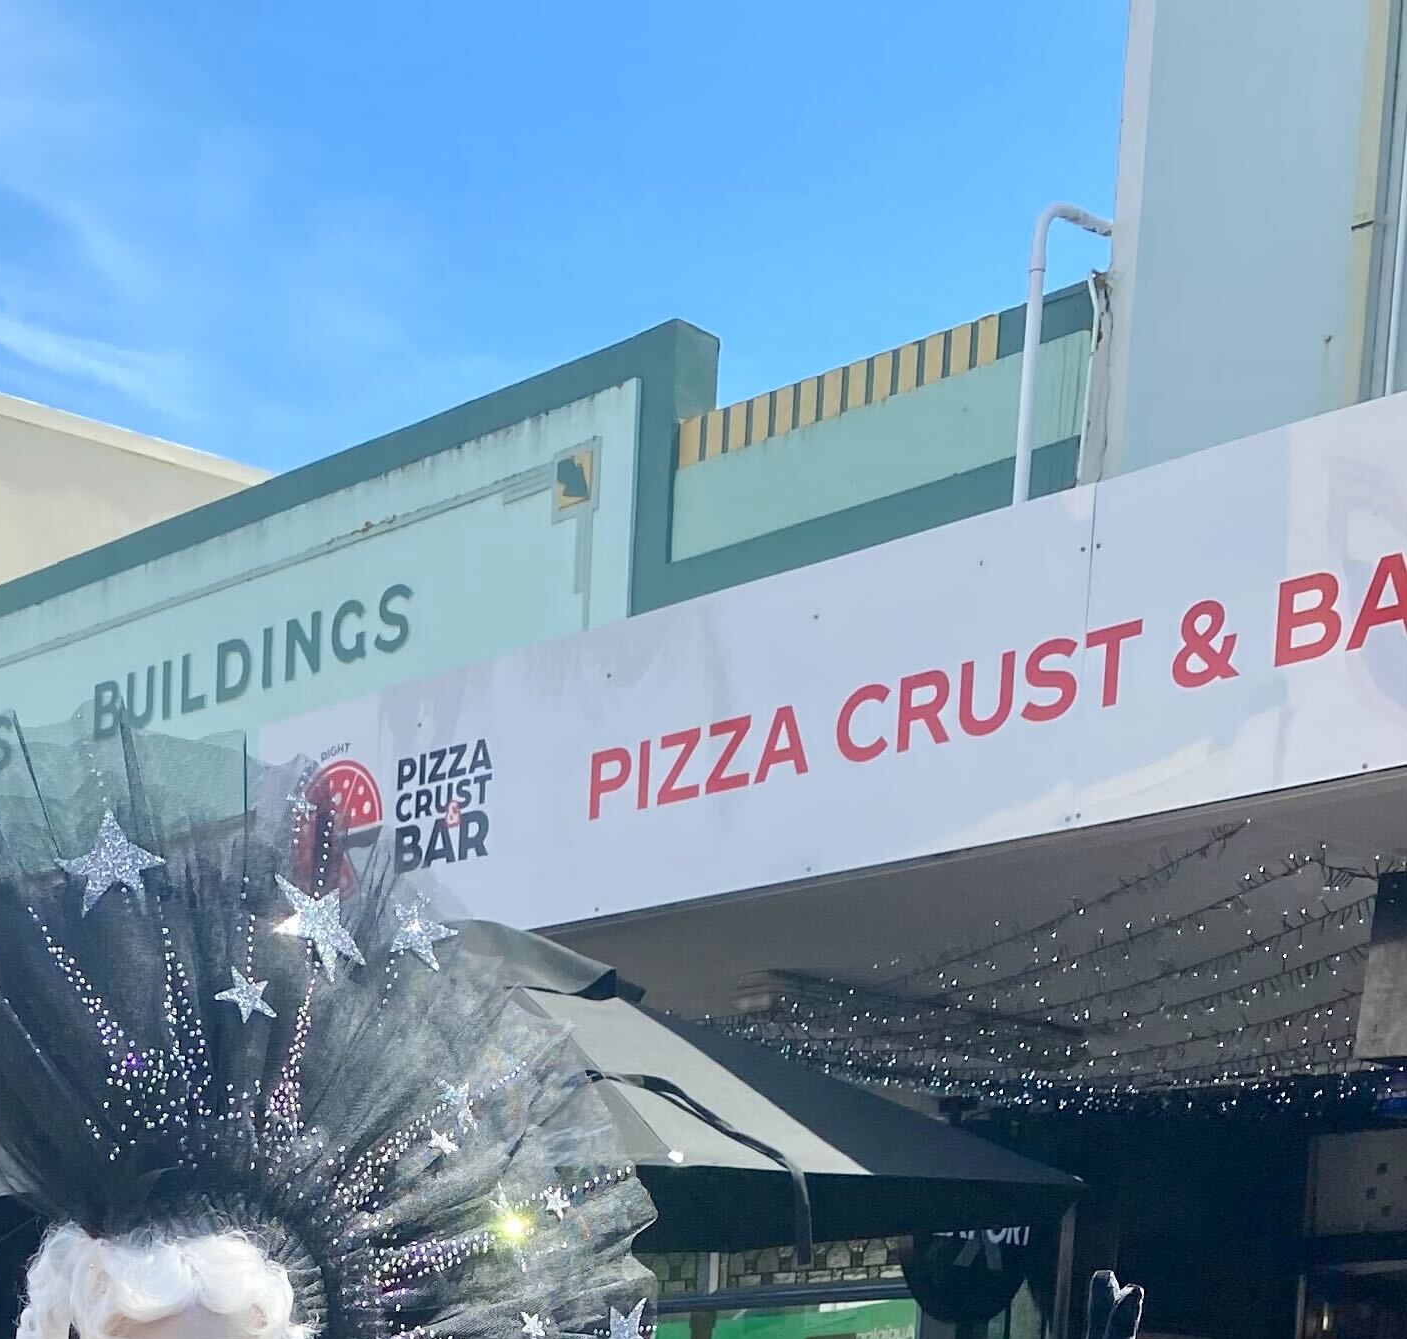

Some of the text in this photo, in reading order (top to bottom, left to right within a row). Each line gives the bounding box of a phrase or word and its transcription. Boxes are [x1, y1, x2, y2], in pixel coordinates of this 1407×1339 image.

[93, 584, 415, 741] BUILDINGS
[589, 705, 808, 820] PIZZA
[837, 619, 1143, 763] CRUST
[1171, 599, 1240, 688] &
[397, 738, 493, 790] PIZZA
[396, 773, 493, 823] CRUST
[394, 810, 489, 873] BAR
